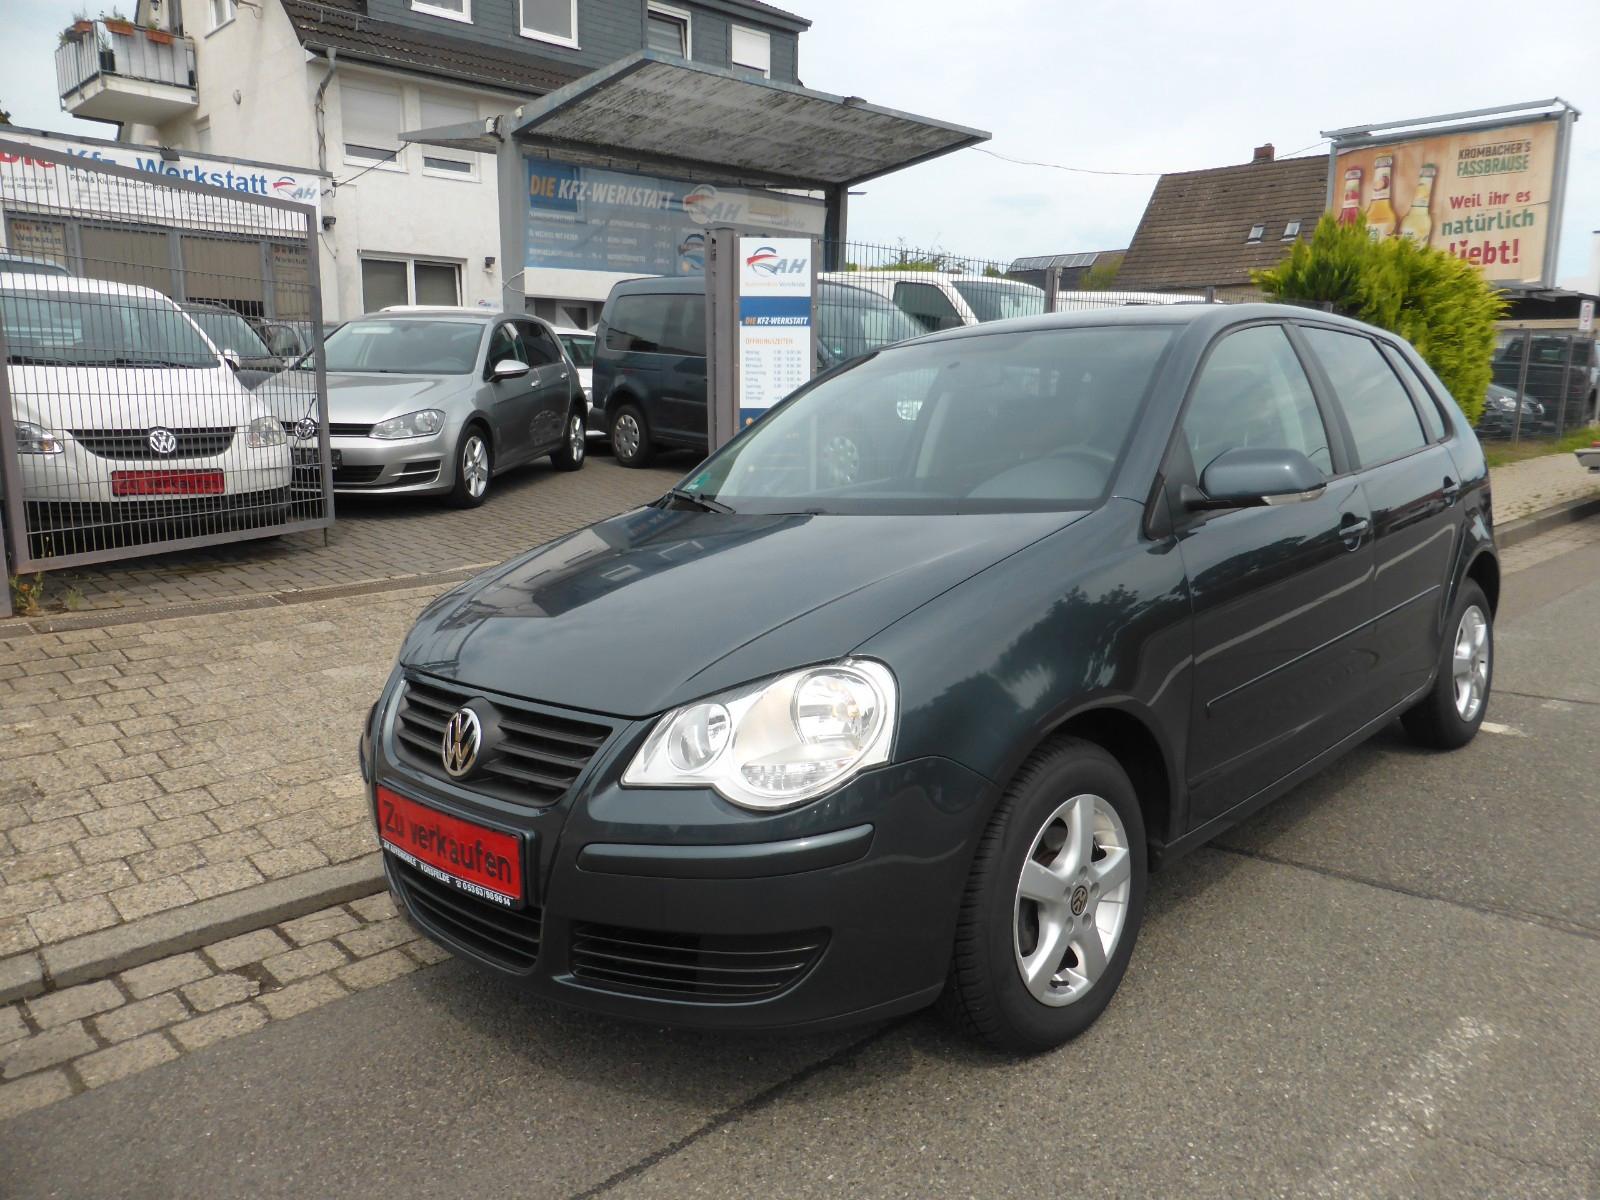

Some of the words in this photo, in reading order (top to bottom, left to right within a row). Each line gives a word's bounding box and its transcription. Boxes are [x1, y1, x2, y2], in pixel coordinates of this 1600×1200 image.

[1457, 154, 1529, 177] FASSBRAUSE
[292, 187, 317, 199] AH
[530, 175, 557, 197] DIE
[558, 178, 675, 209] KFZ-WERKSTATT
[1450, 193, 1482, 209] Weil
[1488, 191, 1509, 206] ihr
[1516, 190, 1531, 203] es
[710, 202, 741, 221] AH
[1442, 208, 1534, 236] natürlich
[775, 258, 807, 274] AH
[757, 316, 809, 325] KFZ-WERKSTATT
[383, 801, 405, 838] Zu
[409, 821, 512, 883] verkaufen
